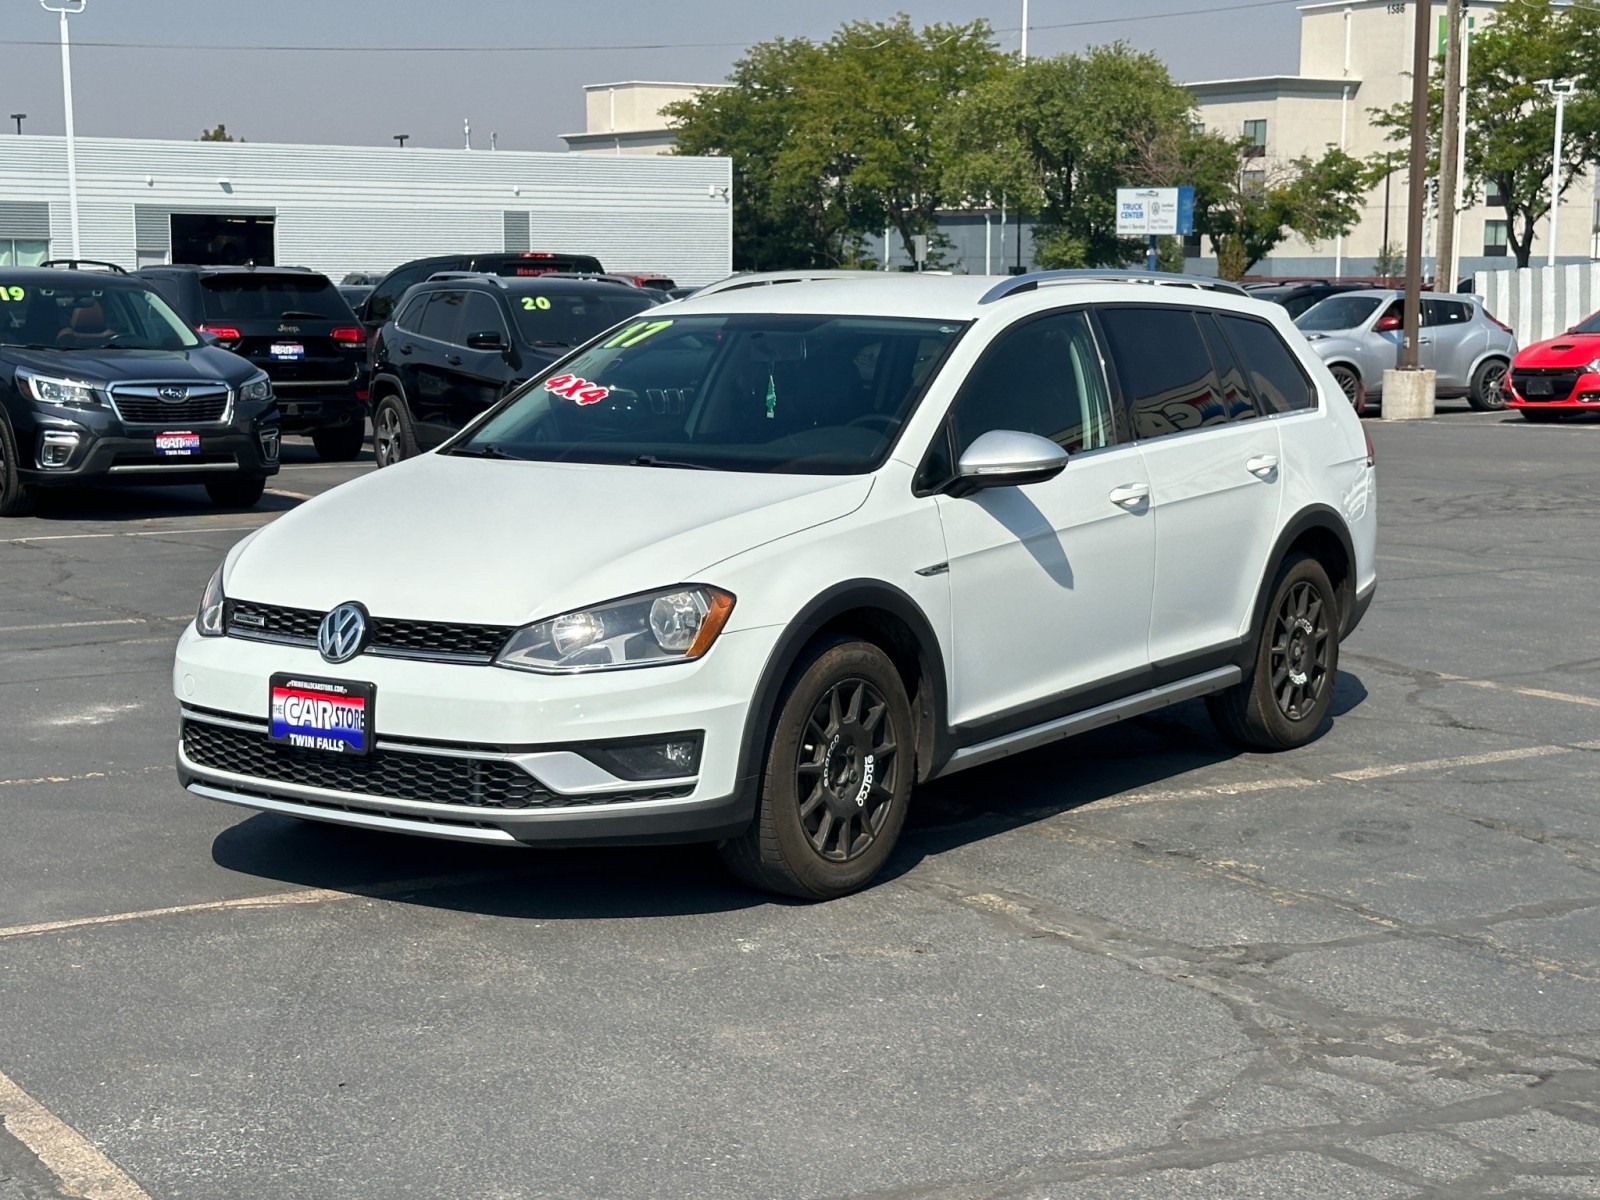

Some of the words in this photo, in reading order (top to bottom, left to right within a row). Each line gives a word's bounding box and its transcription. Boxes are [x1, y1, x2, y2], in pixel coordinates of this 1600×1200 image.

[1120, 211, 1144, 219] CENTER
[0, 286, 25, 301] 19
[521, 296, 551, 310] 20
[277, 324, 299, 333] Jeep
[603, 320, 674, 349] 17
[544, 374, 609, 406] 4X4
[160, 437, 184, 449] CAR
[273, 704, 283, 714] THE
[284, 695, 333, 730] CAR
[335, 706, 365, 730] STORE
[290, 734, 314, 748] TWIN
[317, 737, 344, 752] FALLS
